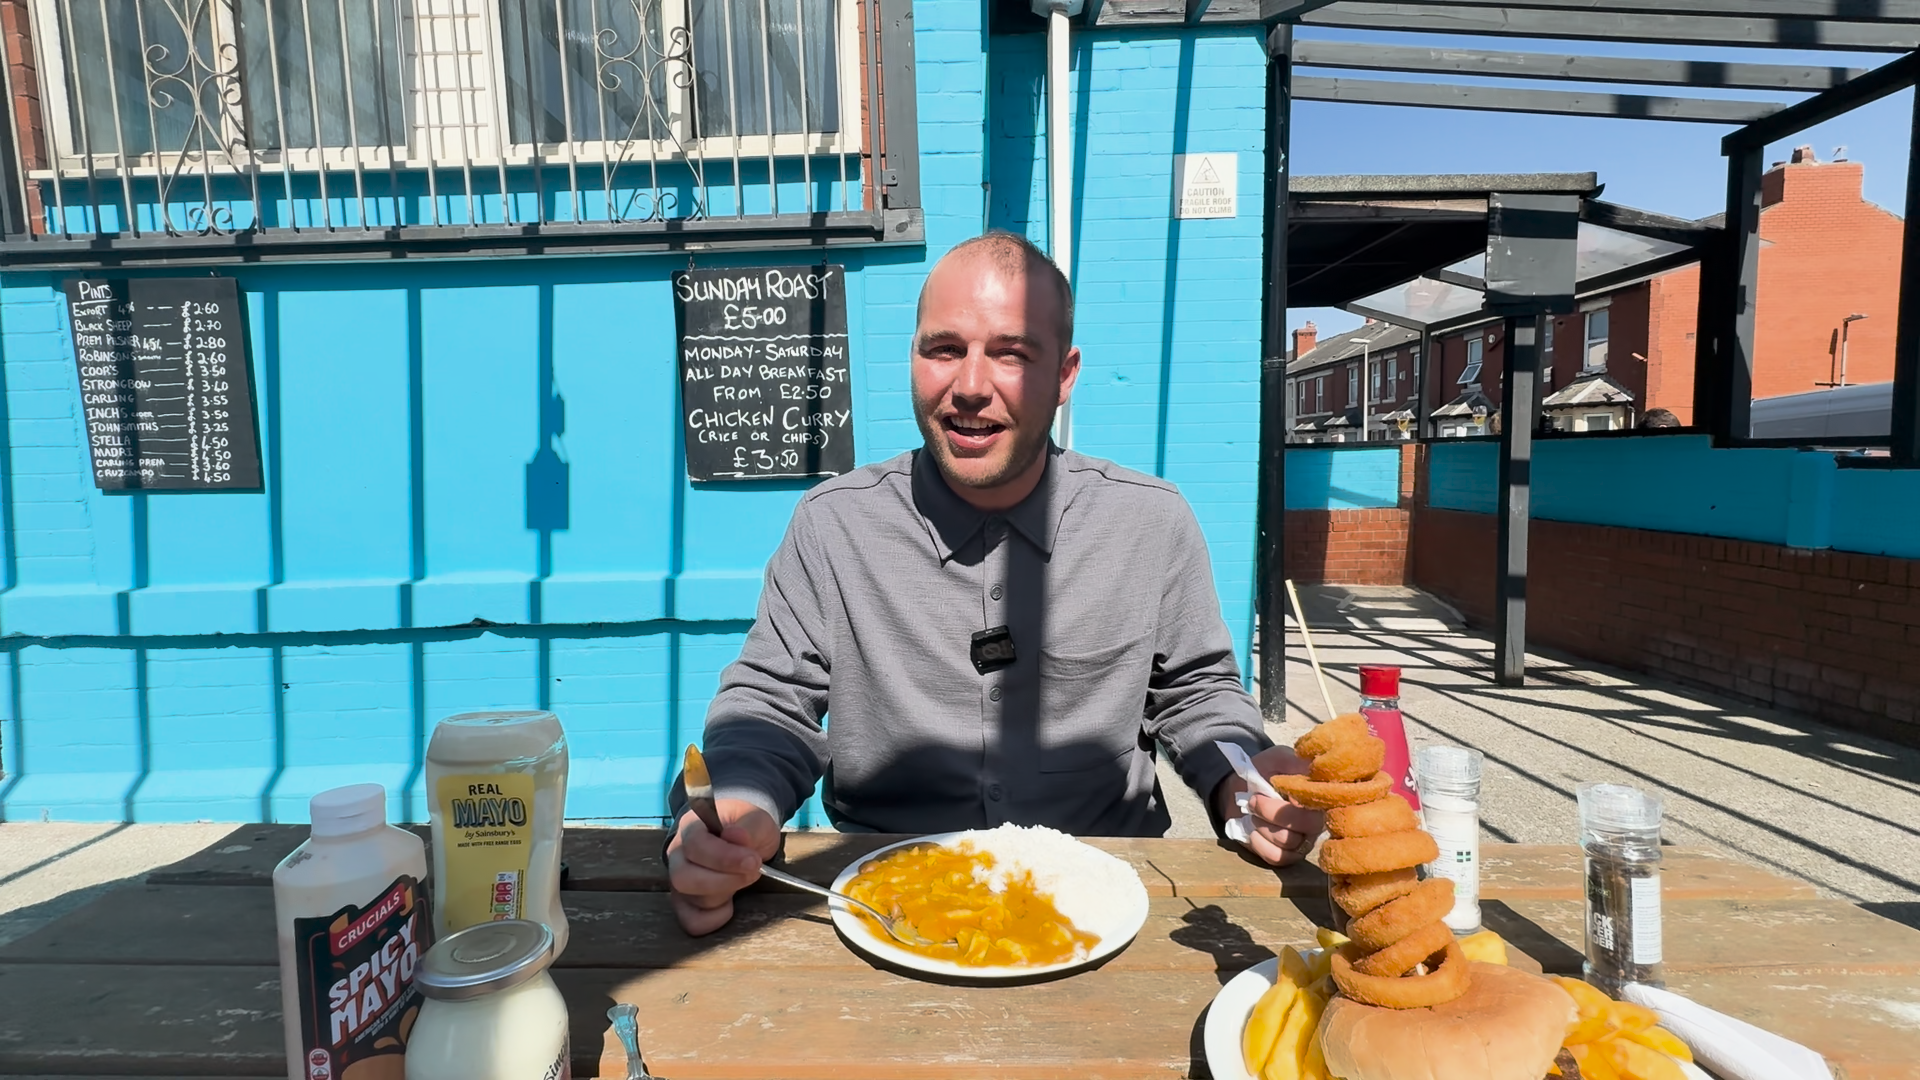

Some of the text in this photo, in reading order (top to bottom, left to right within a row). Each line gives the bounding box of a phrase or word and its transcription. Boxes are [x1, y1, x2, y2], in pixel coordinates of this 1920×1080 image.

[1187, 187, 1224, 197] CAUTION
[1180, 197, 1232, 206] FRAGILE ROOF
[1192, 206, 1206, 214] NOT
[1209, 206, 1232, 214] CLIMB
[676, 269, 834, 303] SUNDAY ROAST
[74, 319, 104, 332] BLACK
[105, 318, 132, 332] SHEEP
[76, 332, 103, 347] PREM
[685, 364, 847, 383] ALL DAY BREAKFAST
[82, 379, 151, 391] STRONGBOW
[83, 393, 135, 404] CARLING
[713, 385, 762, 402] FROM
[688, 405, 851, 431] CHICKEN CURRY
[91, 434, 131, 447] STELLA
[750, 431, 770, 442] OR
[94, 447, 132, 458] MADRI
[138, 457, 165, 467] PREM
[468, 783, 503, 796] REAL
[451, 797, 528, 828] MAYO
[464, 829, 516, 840] by Sainsbury's
[338, 891, 400, 949] CRUCIALS
[328, 912, 418, 1009] SPICY
[330, 941, 418, 1046] MAYO
